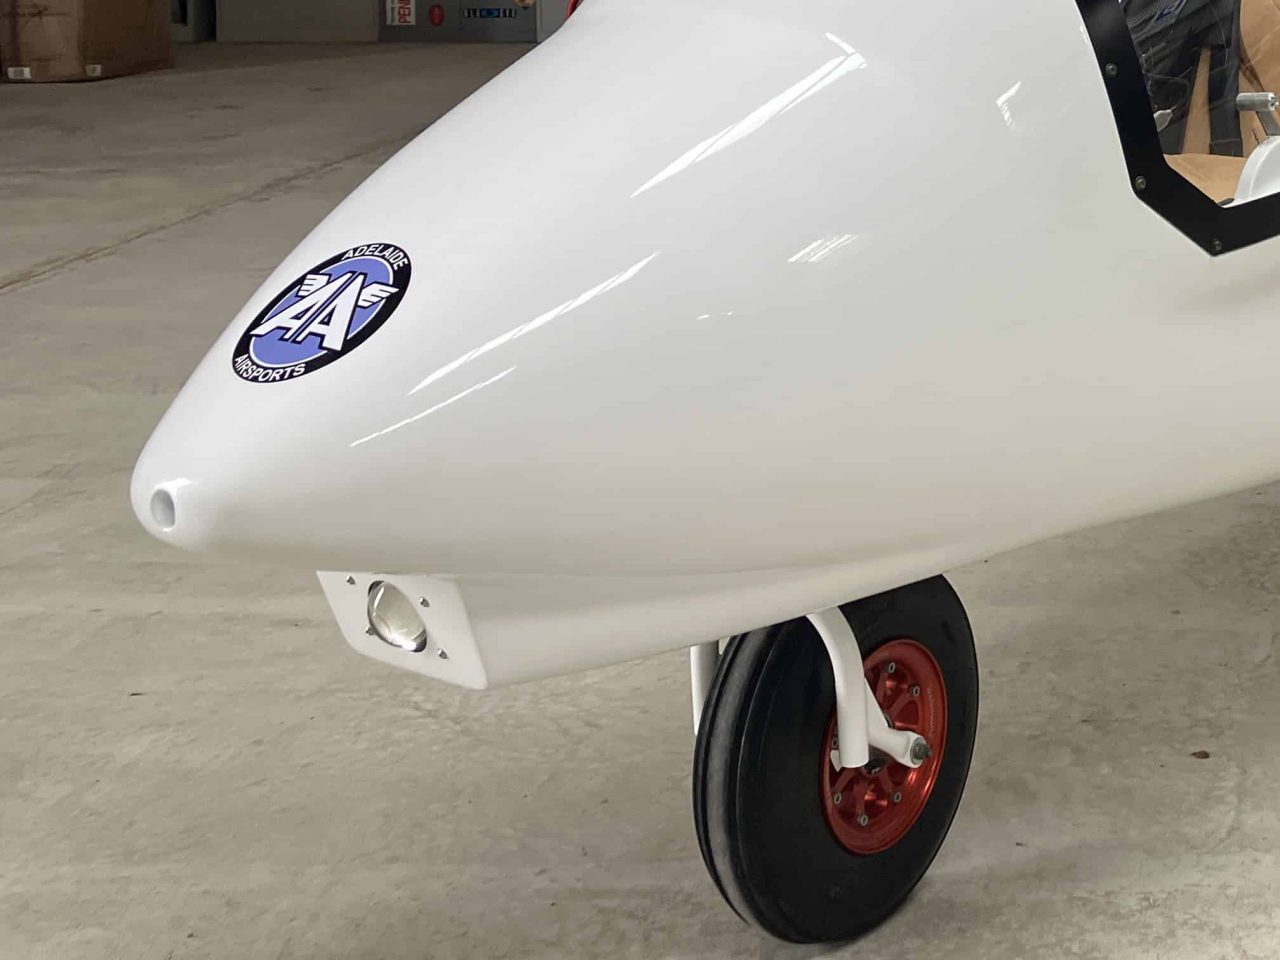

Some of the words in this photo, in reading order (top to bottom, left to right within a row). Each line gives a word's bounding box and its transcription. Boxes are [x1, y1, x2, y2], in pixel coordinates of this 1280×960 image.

[341, 244, 409, 271] ADELAIDE
[249, 271, 366, 351] AA
[234, 354, 306, 382] AIRSPORTS
